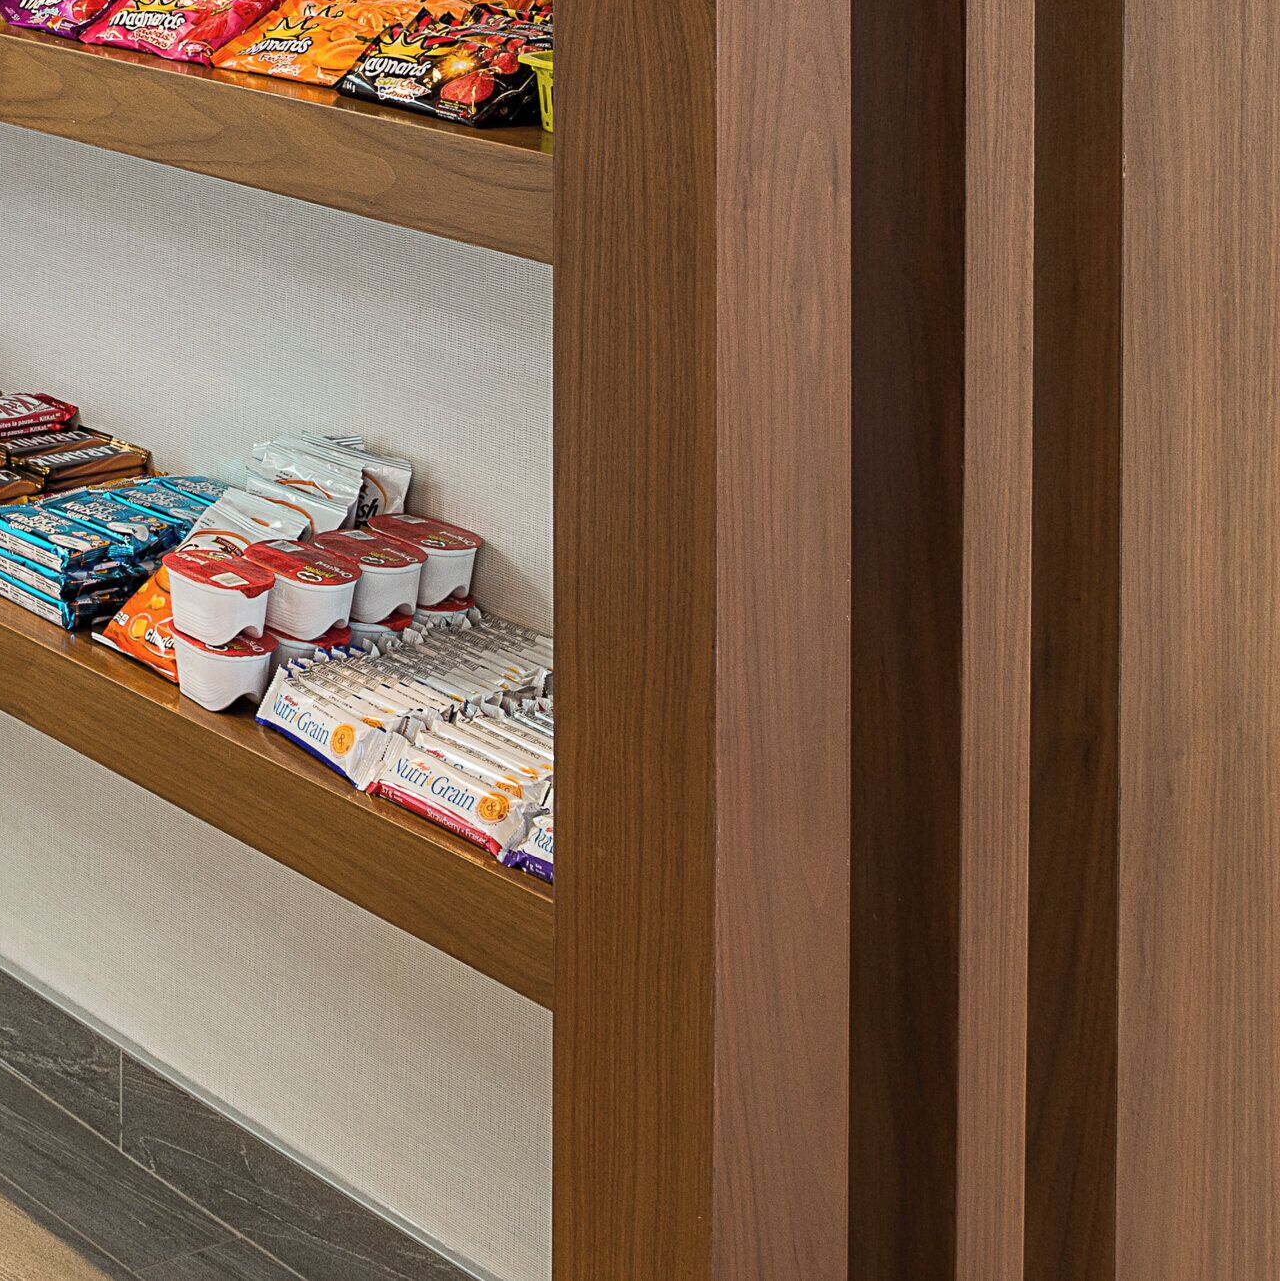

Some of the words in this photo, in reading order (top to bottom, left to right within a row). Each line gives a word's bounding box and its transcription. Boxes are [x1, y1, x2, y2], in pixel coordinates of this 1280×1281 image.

[108, 10, 186, 30] Maynards
[28, 444, 132, 467] CARAMILK
[431, 774, 477, 812] Grain
[426, 808, 461, 835] Strawberry
